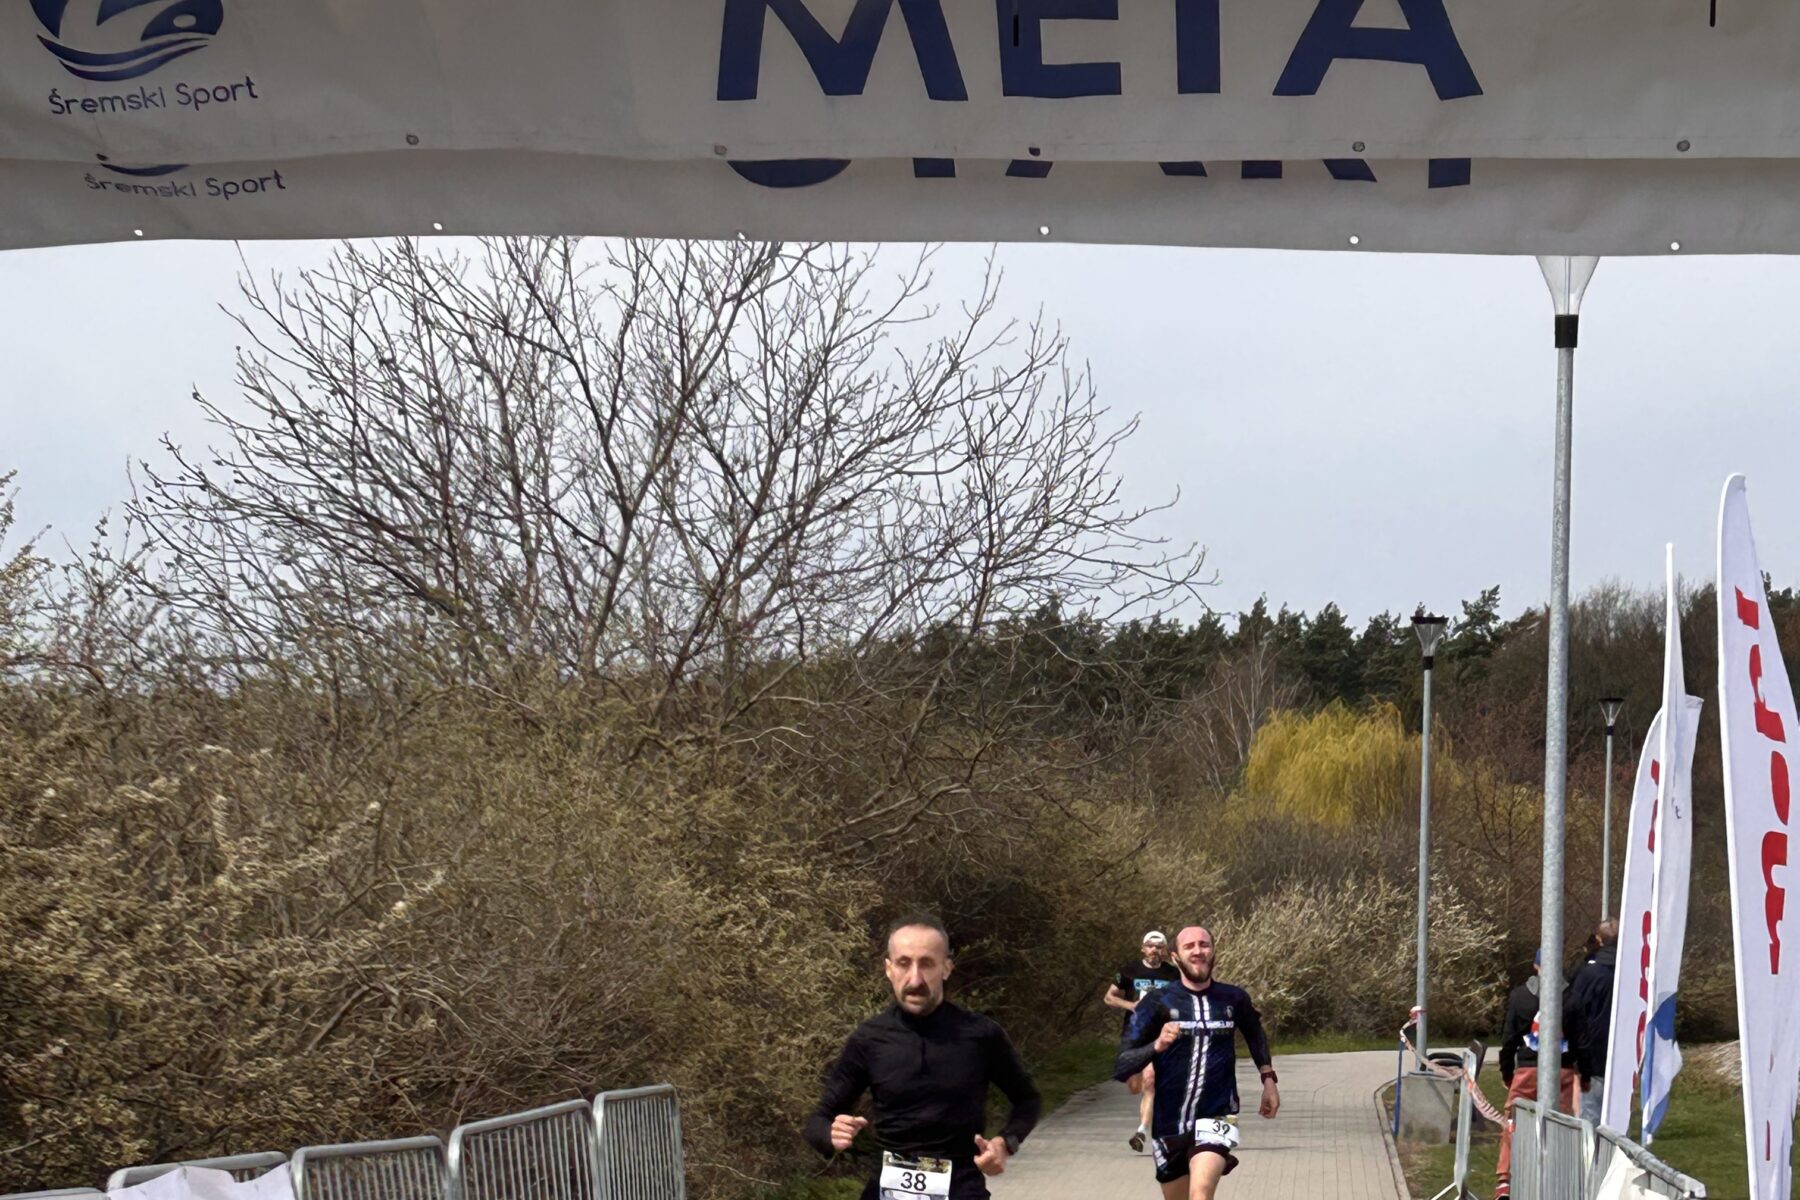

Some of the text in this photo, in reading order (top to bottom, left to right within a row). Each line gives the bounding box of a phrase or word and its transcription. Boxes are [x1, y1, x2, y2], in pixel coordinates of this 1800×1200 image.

[48, 75, 259, 115] Śremski Sport
[205, 168, 286, 200] Sport
[900, 1171, 927, 1192] 38
